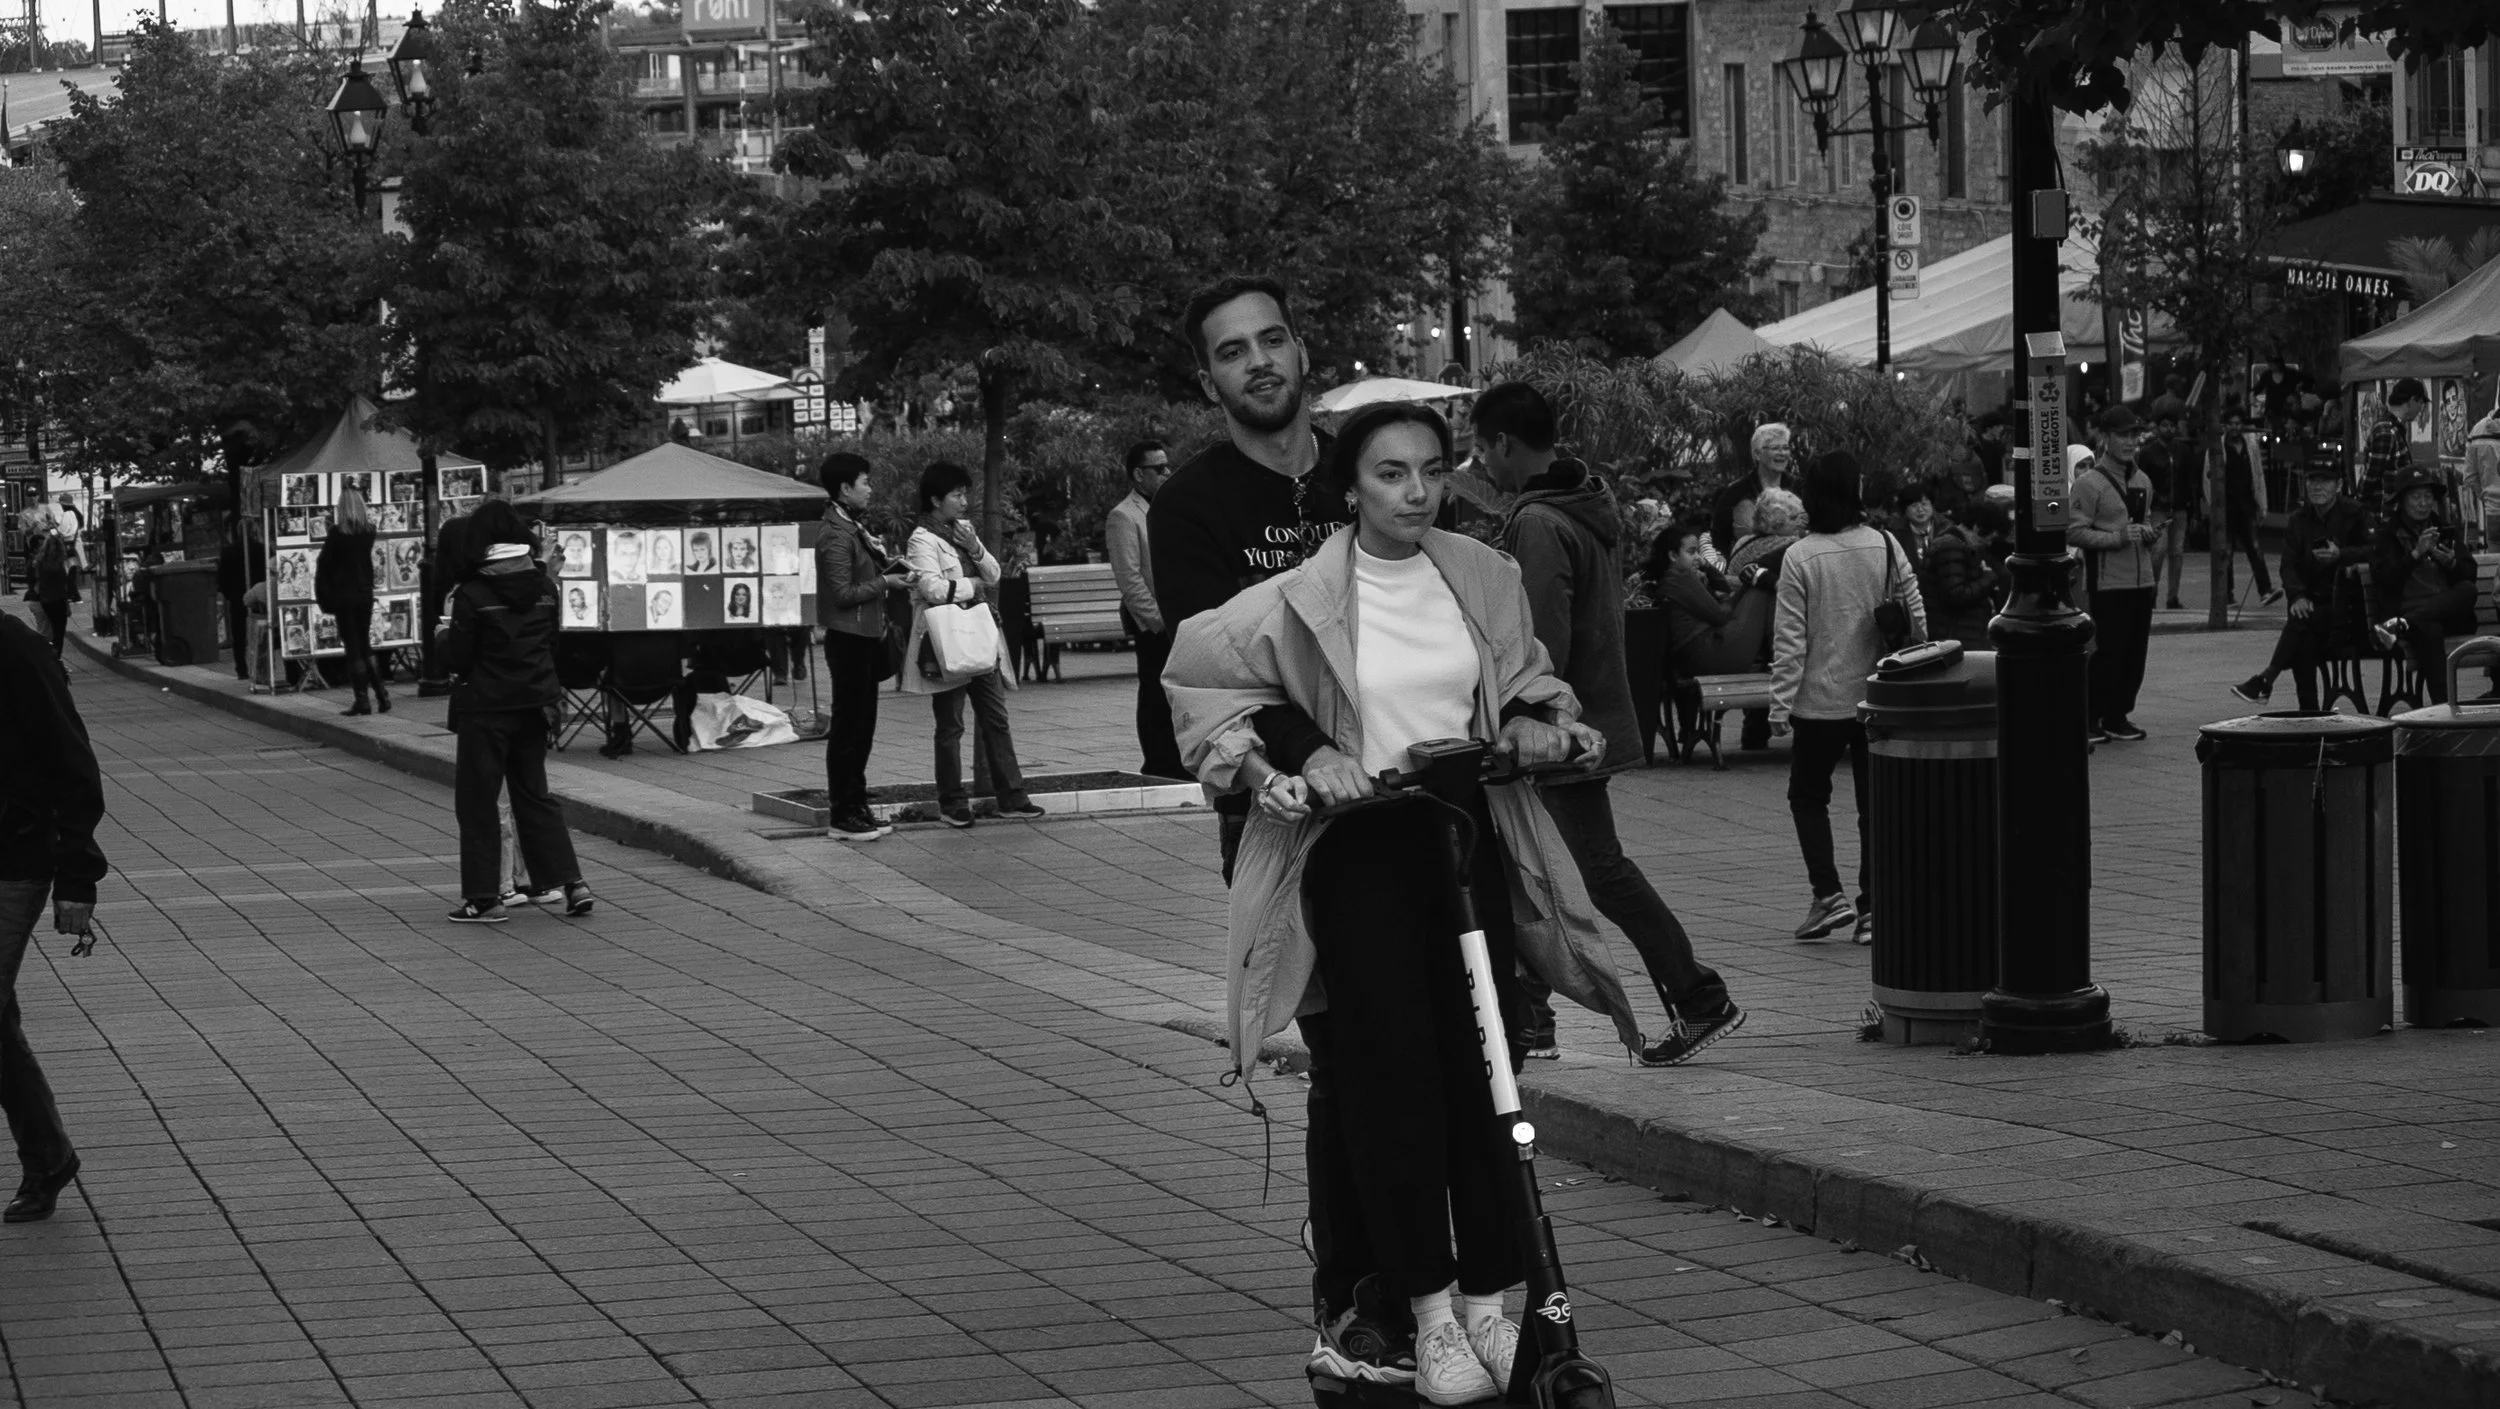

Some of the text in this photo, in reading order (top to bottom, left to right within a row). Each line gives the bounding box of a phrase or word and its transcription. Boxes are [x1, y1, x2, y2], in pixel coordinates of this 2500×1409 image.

[2414, 171, 2450, 193] DQ
[2040, 410, 2050, 476] ON RECYCLE
[2051, 457, 2061, 475] LES
[1265, 521, 1345, 546] CONQUE
